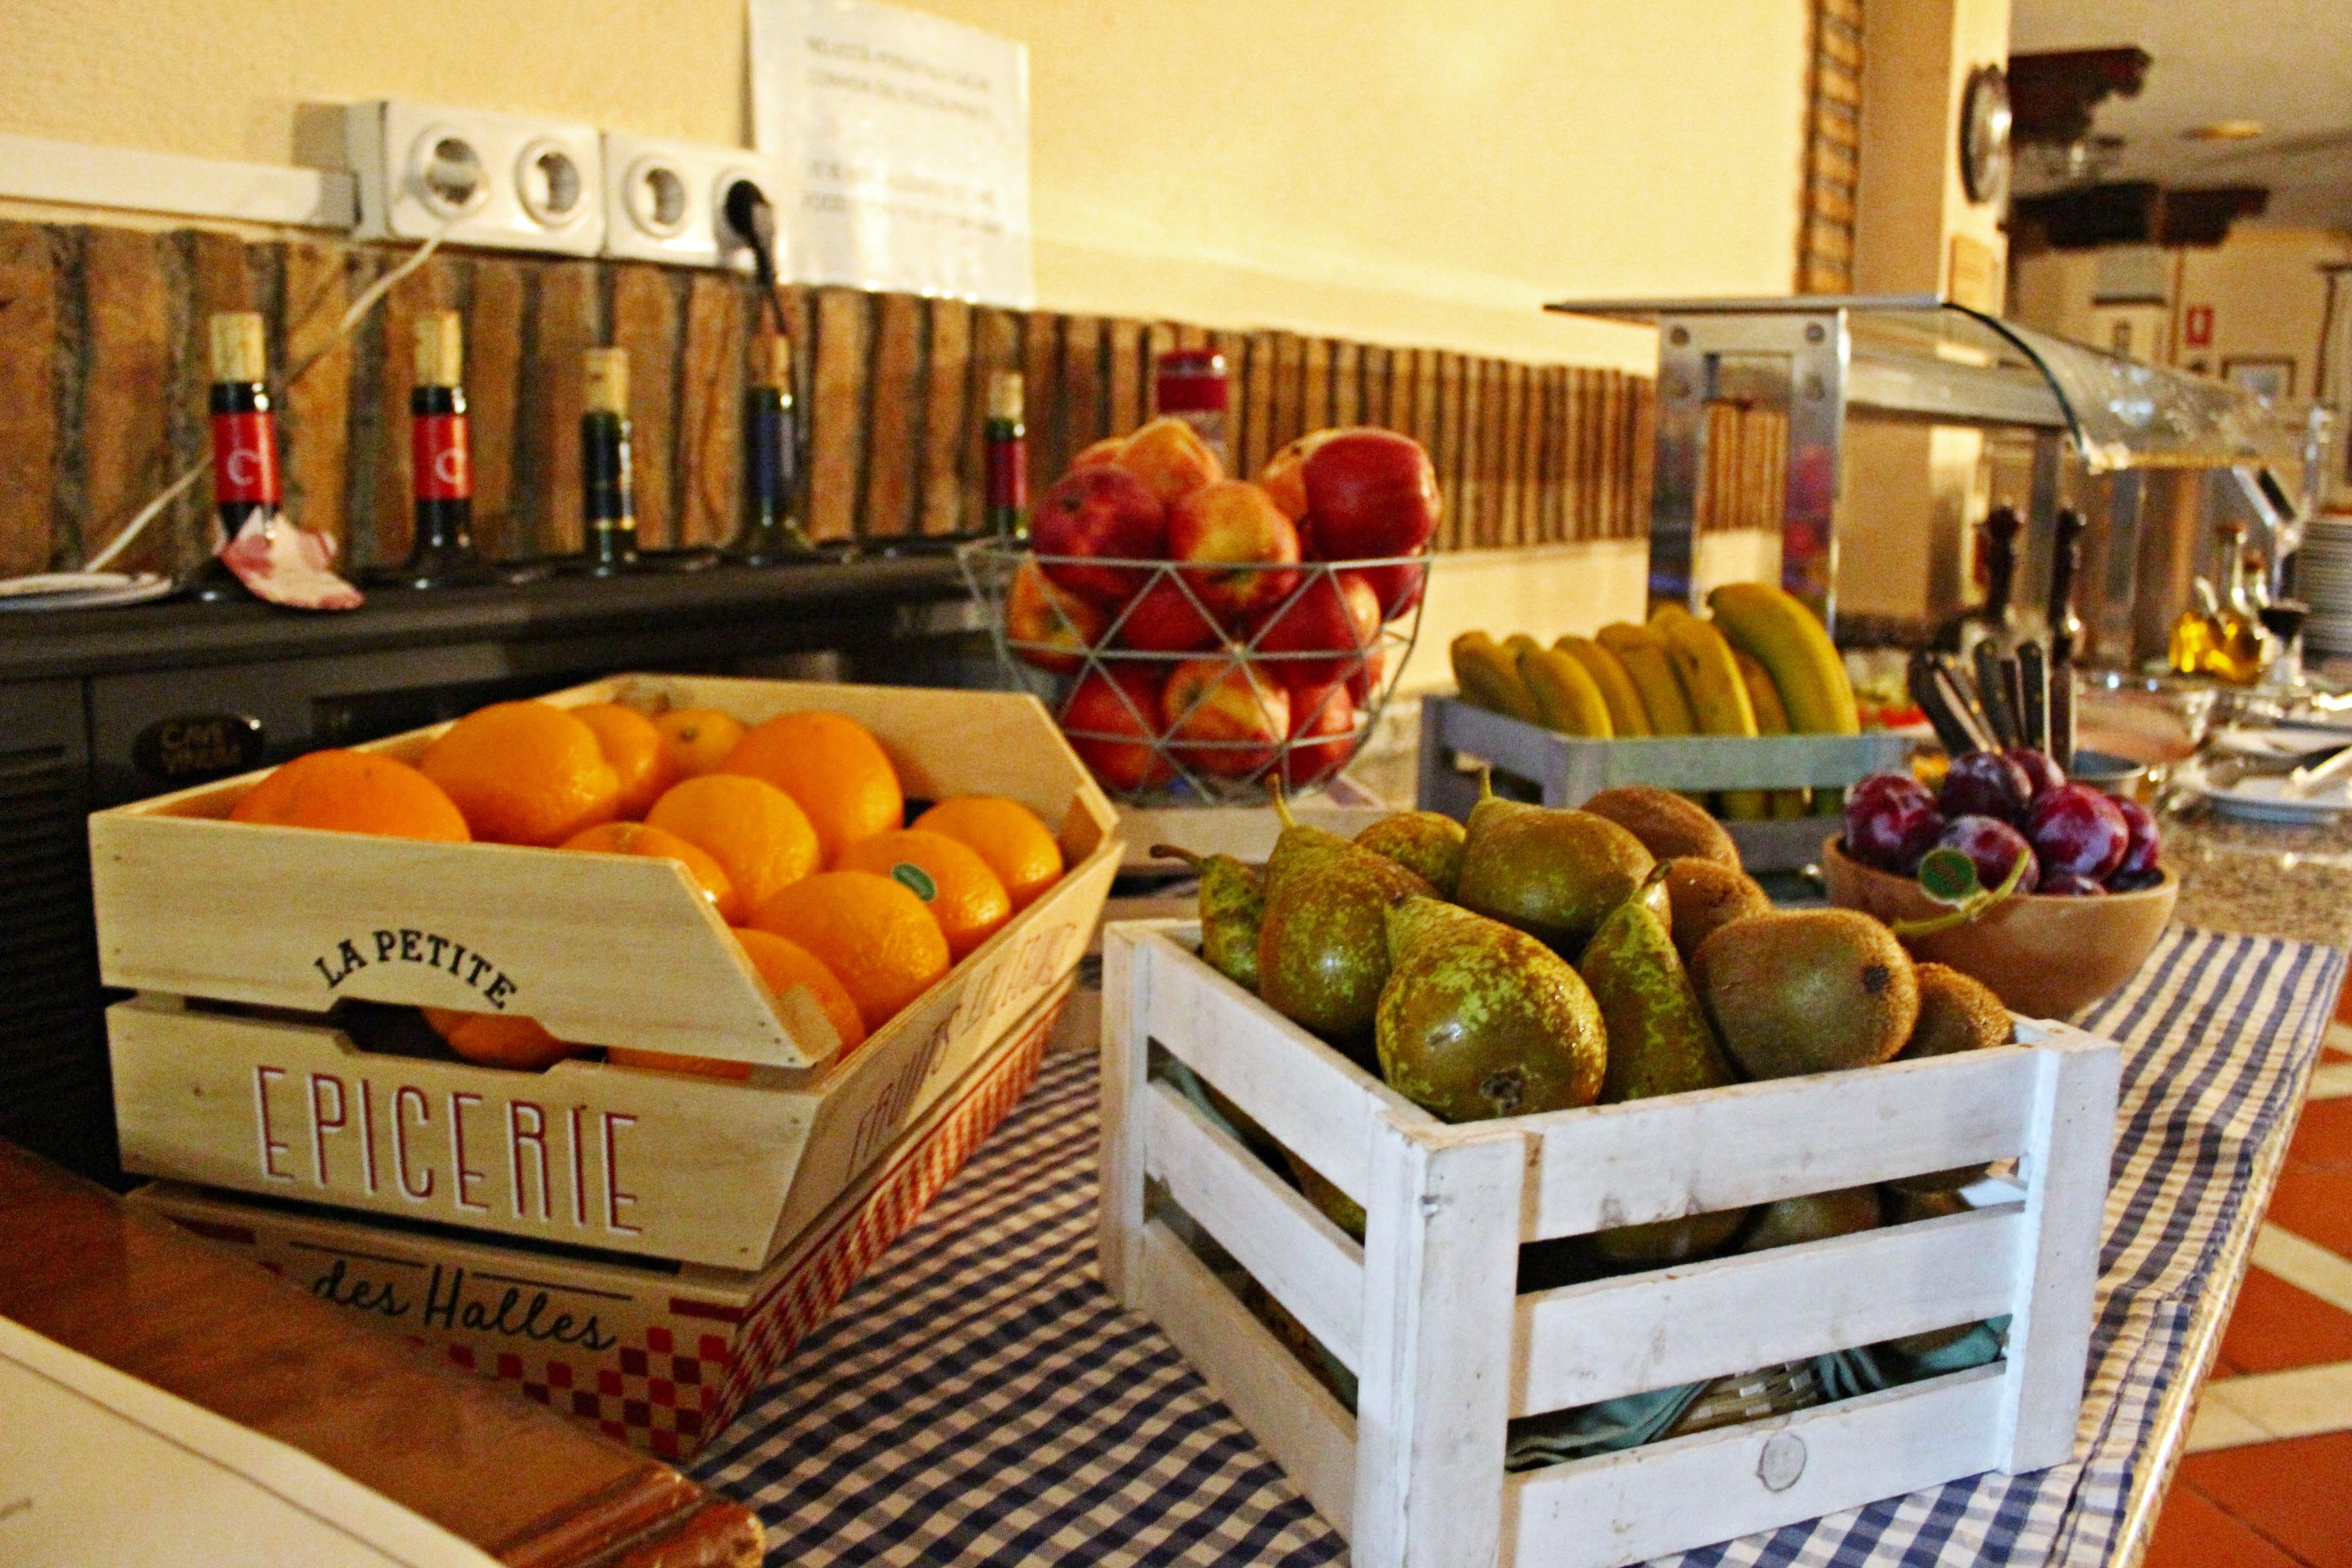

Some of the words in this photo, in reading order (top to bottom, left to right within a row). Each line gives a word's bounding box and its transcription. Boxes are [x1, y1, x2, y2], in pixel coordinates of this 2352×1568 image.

[314, 938, 367, 989] LA
[372, 929, 517, 1009] PETITE
[255, 1065, 644, 1236] EPICERIE
[313, 1259, 412, 1319] des
[421, 1262, 618, 1351] Halles
